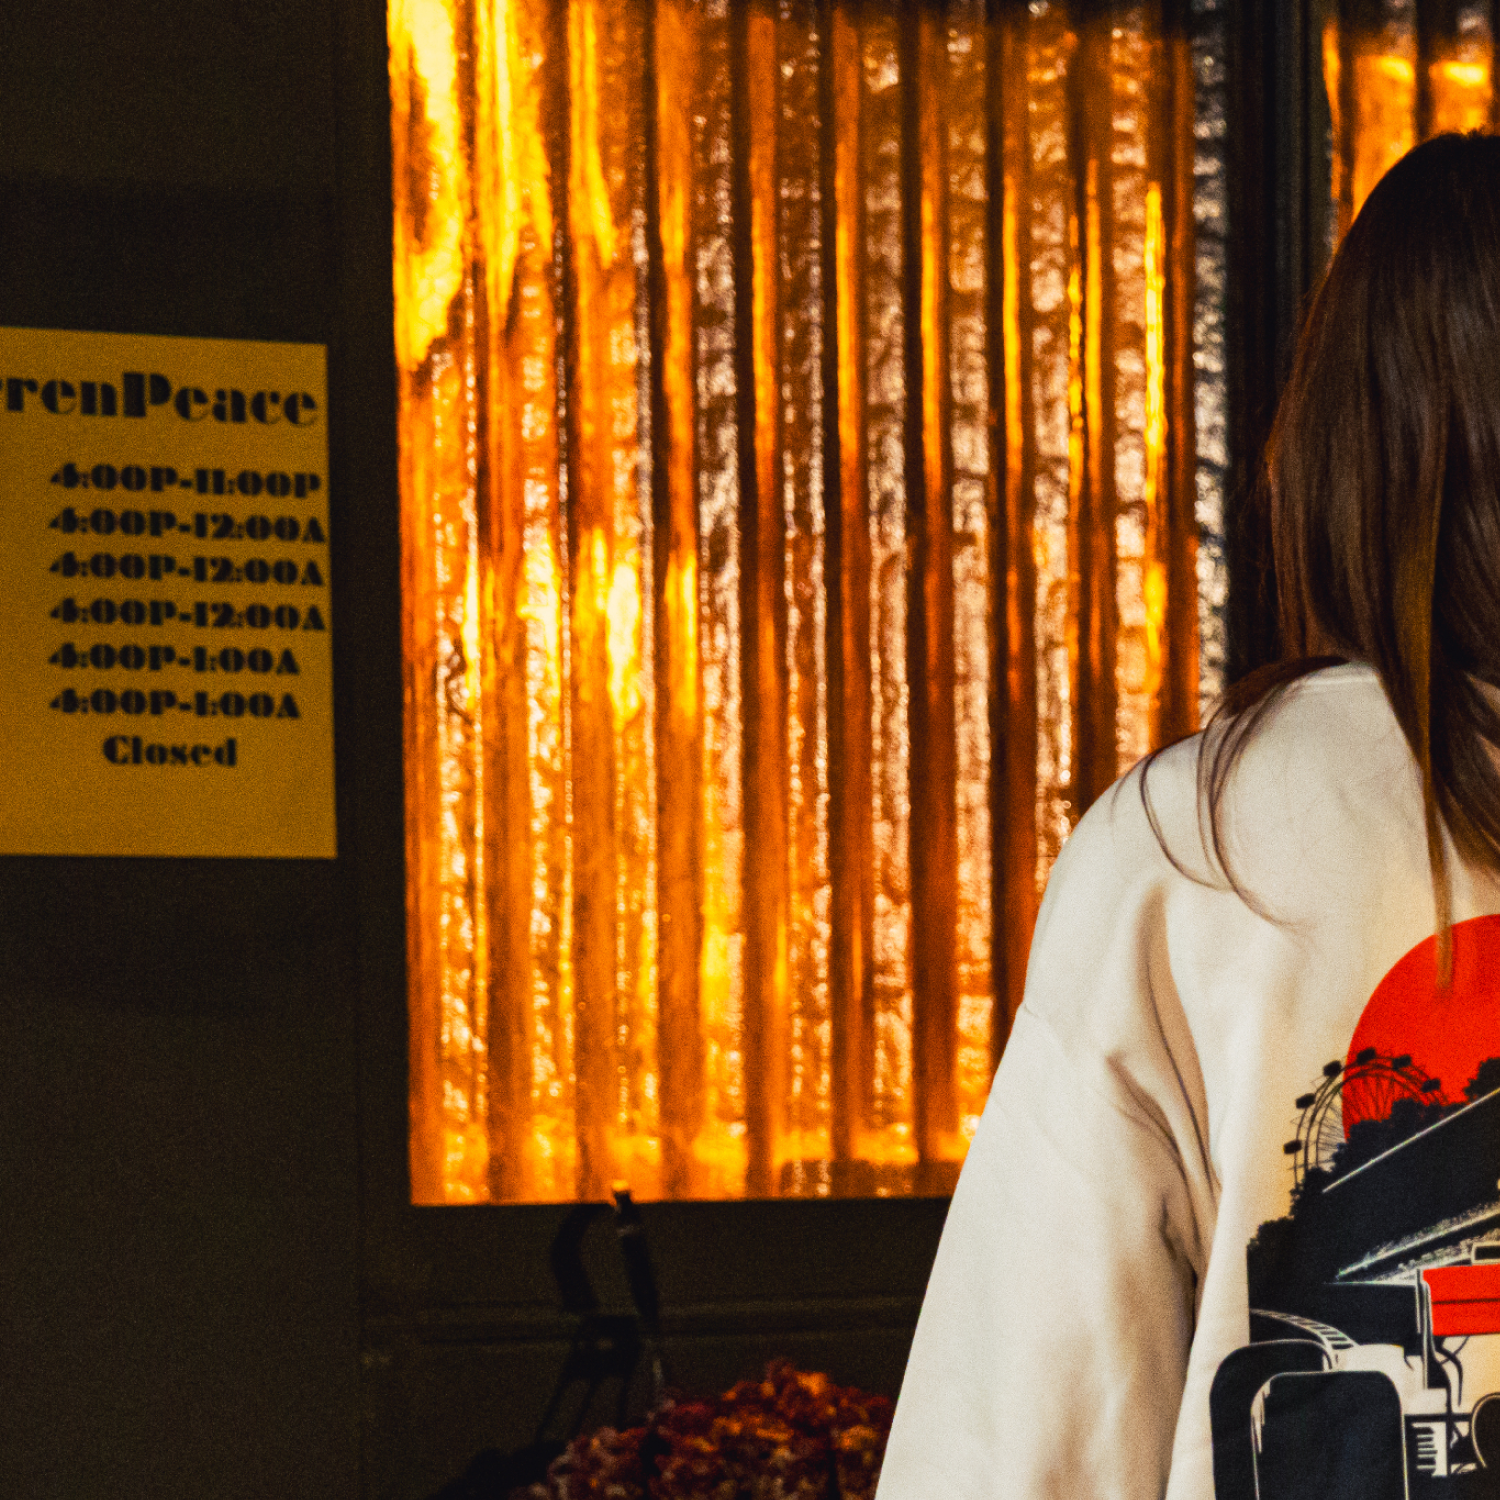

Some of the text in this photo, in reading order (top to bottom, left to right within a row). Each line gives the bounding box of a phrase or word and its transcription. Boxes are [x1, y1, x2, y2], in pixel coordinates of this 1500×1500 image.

[0, 370, 318, 426] renPeace
[48, 462, 321, 499] 4:00P-11:00P
[48, 506, 326, 544] 4:00P-12:00A
[48, 550, 325, 588] 4:00P-12:00A
[48, 597, 326, 632] 4:00P-12:00A
[48, 641, 300, 676] 4:00P-1:00A
[48, 687, 301, 719] 4:00P-1:00A
[102, 733, 238, 768] Closed
